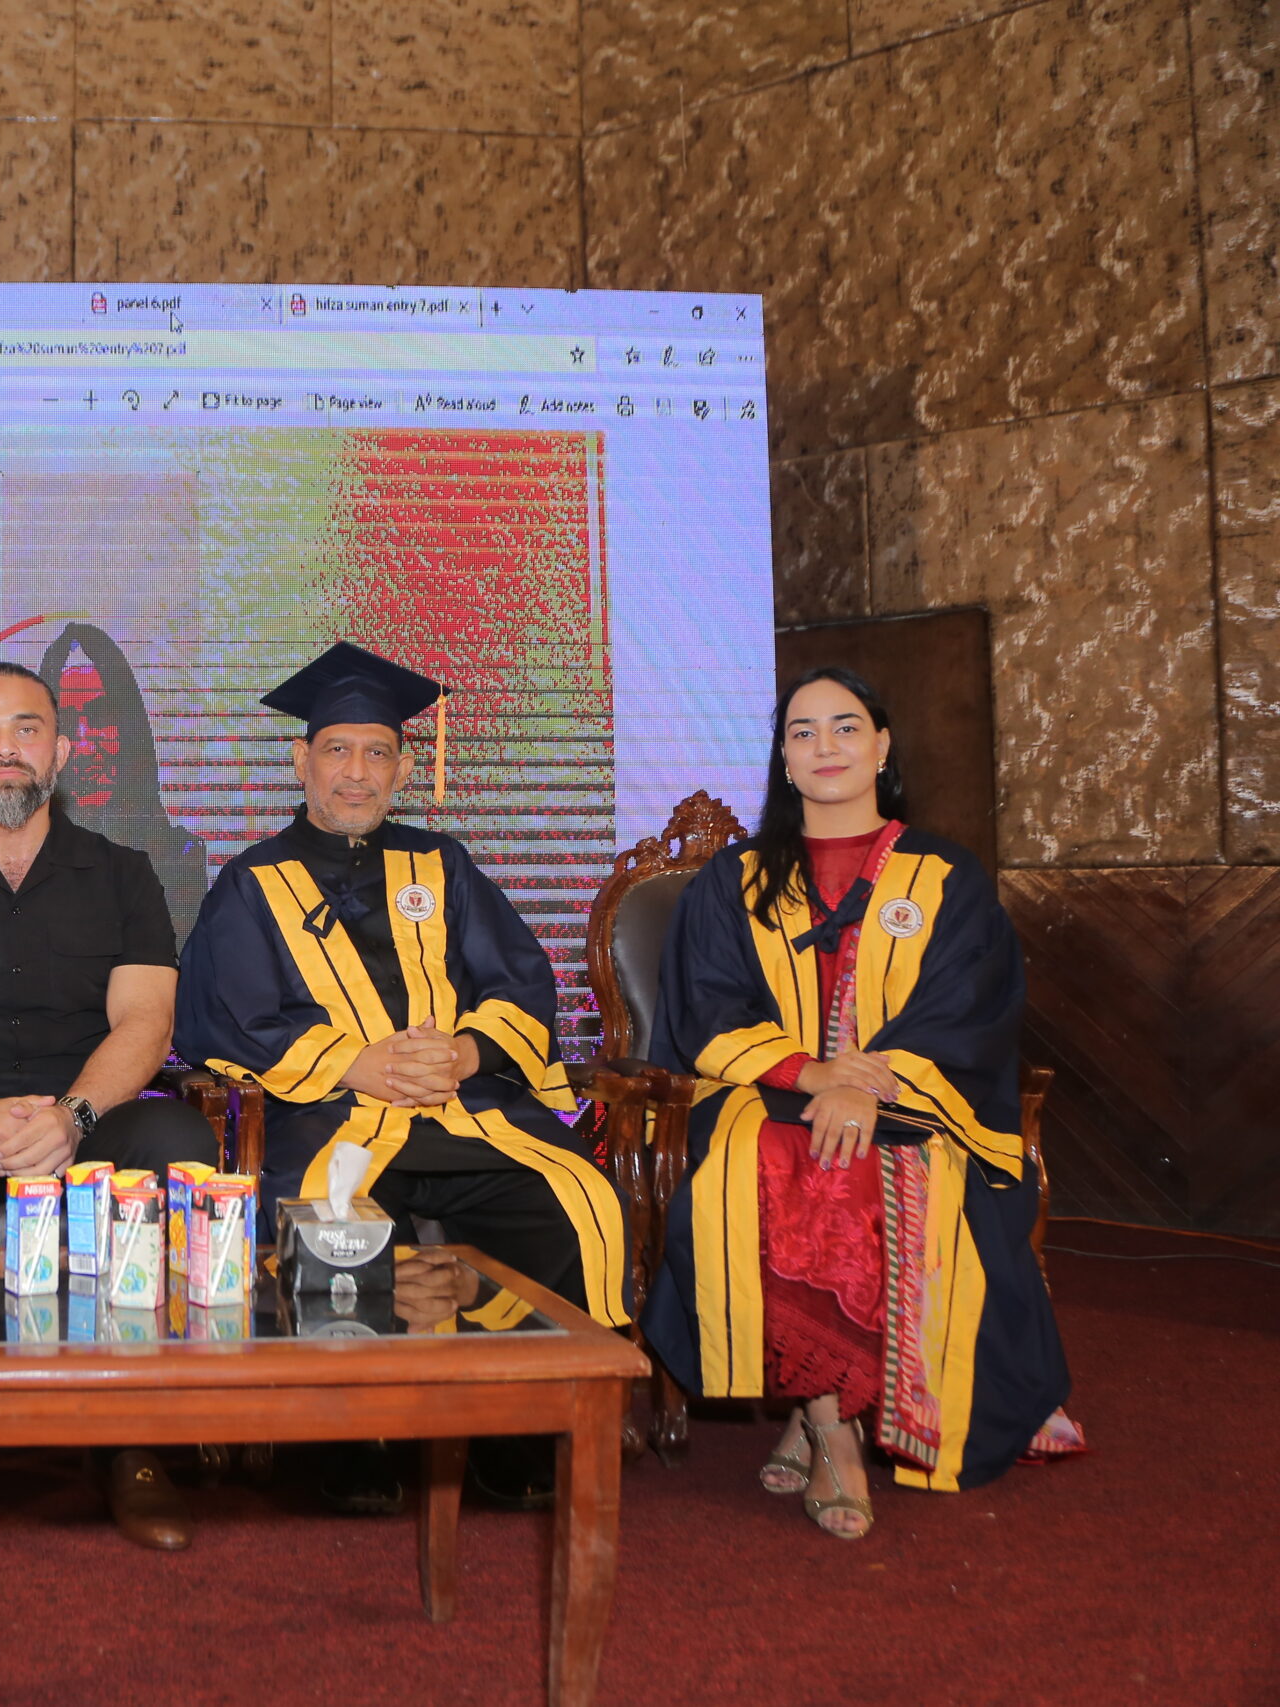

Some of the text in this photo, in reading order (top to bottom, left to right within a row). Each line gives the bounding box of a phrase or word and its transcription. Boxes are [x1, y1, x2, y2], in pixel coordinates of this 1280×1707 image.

[117, 296, 148, 312] panel
[316, 297, 343, 311] hifza
[346, 300, 384, 312] suman
[386, 299, 416, 315] entry
[225, 394, 238, 406] Ft
[256, 397, 282, 410] page
[329, 395, 383, 412] Page view
